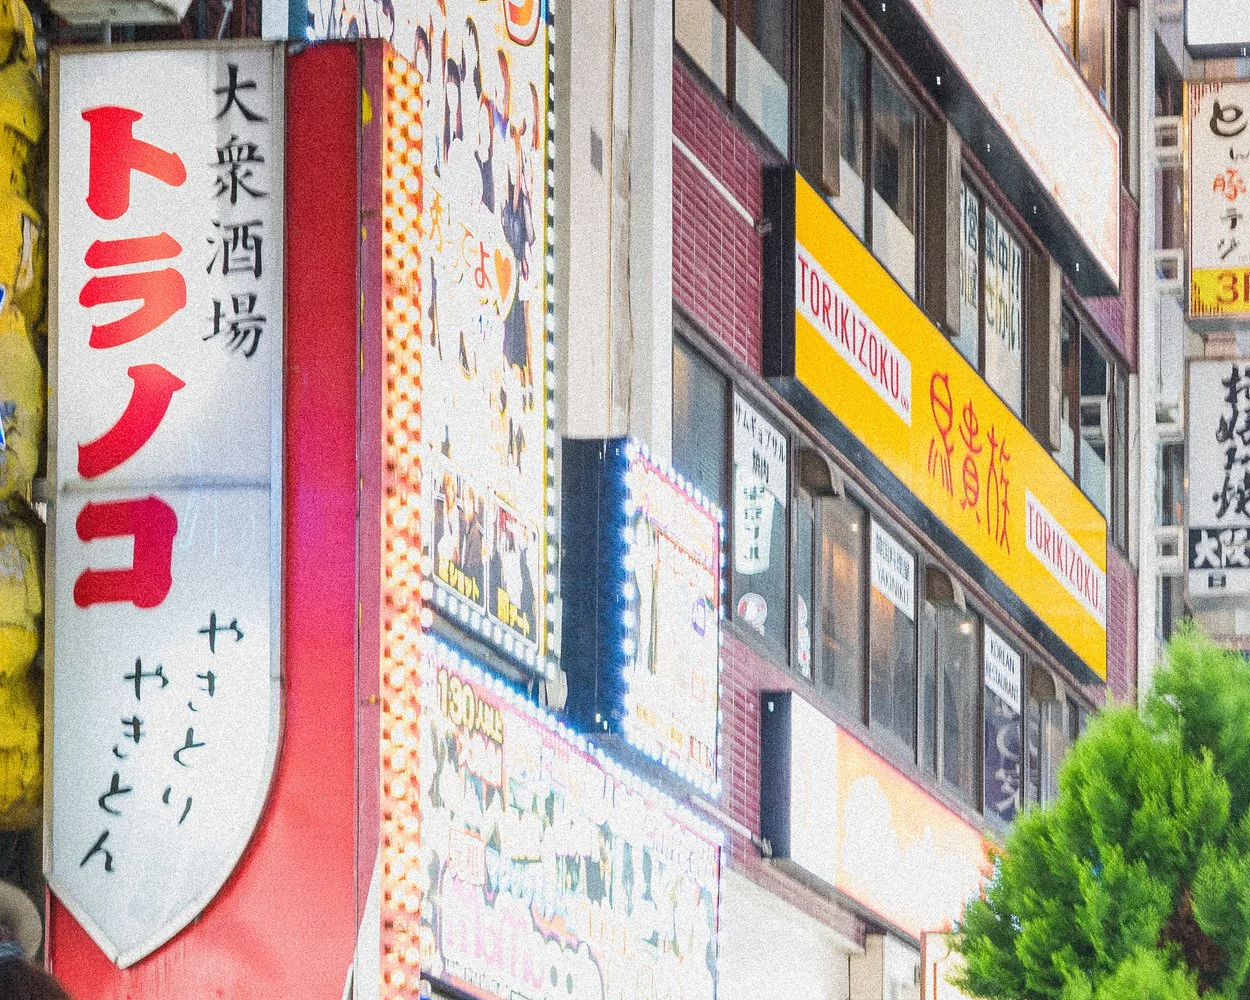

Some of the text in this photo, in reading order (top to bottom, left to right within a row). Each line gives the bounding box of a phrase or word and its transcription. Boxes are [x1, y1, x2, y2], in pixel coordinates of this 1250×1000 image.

[203, 64, 269, 360] 大衆酒場
[73, 106, 188, 609] トラノコ
[797, 255, 901, 400] TORIKIZOKU
[989, 635, 1015, 674] KOREAN
[1028, 503, 1099, 608] TORIKIZOKU
[80, 656, 169, 875] やきとん
[162, 610, 245, 826] やきとり
